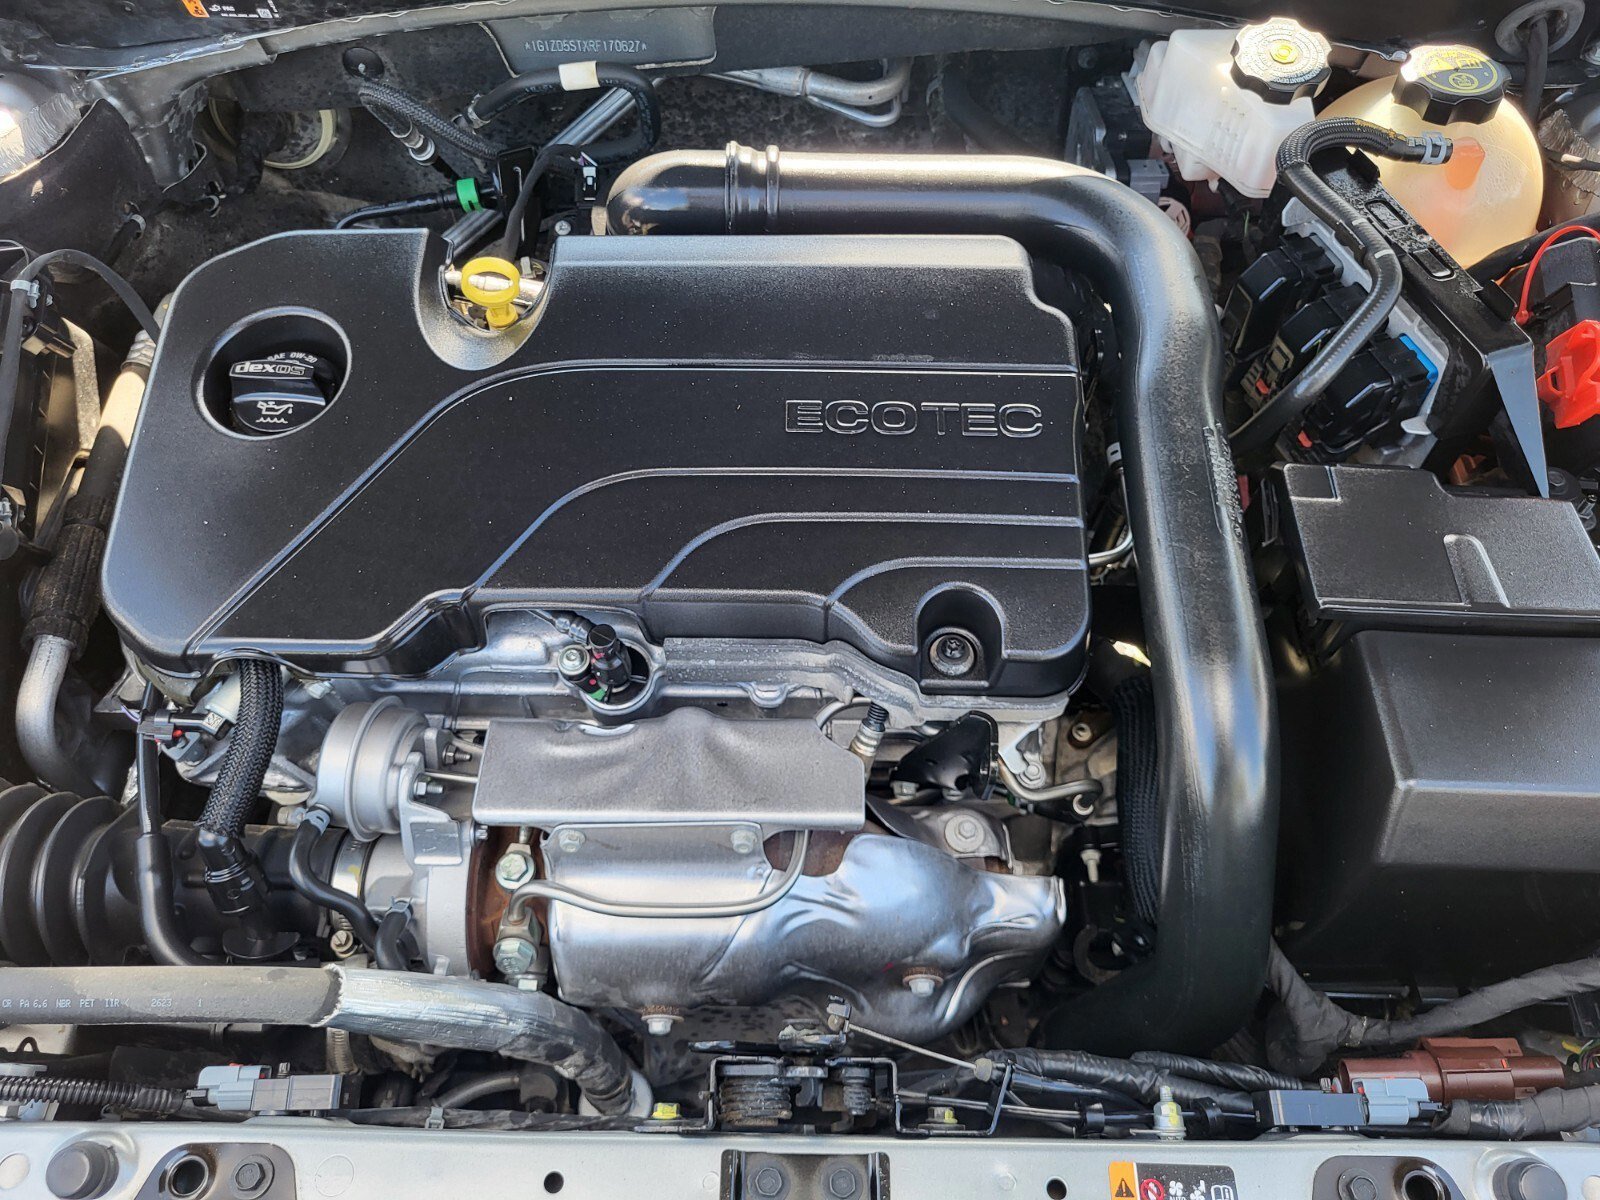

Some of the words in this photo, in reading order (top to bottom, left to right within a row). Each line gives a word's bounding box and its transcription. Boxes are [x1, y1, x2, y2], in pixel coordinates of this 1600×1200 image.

[235, 361, 306, 376] dexos
[785, 400, 1043, 438] ECOTEC
[20, 999, 30, 1008] PA
[33, 999, 48, 1008] 6.6
[80, 999, 95, 1008] PET
[151, 998, 172, 1008] 2623
